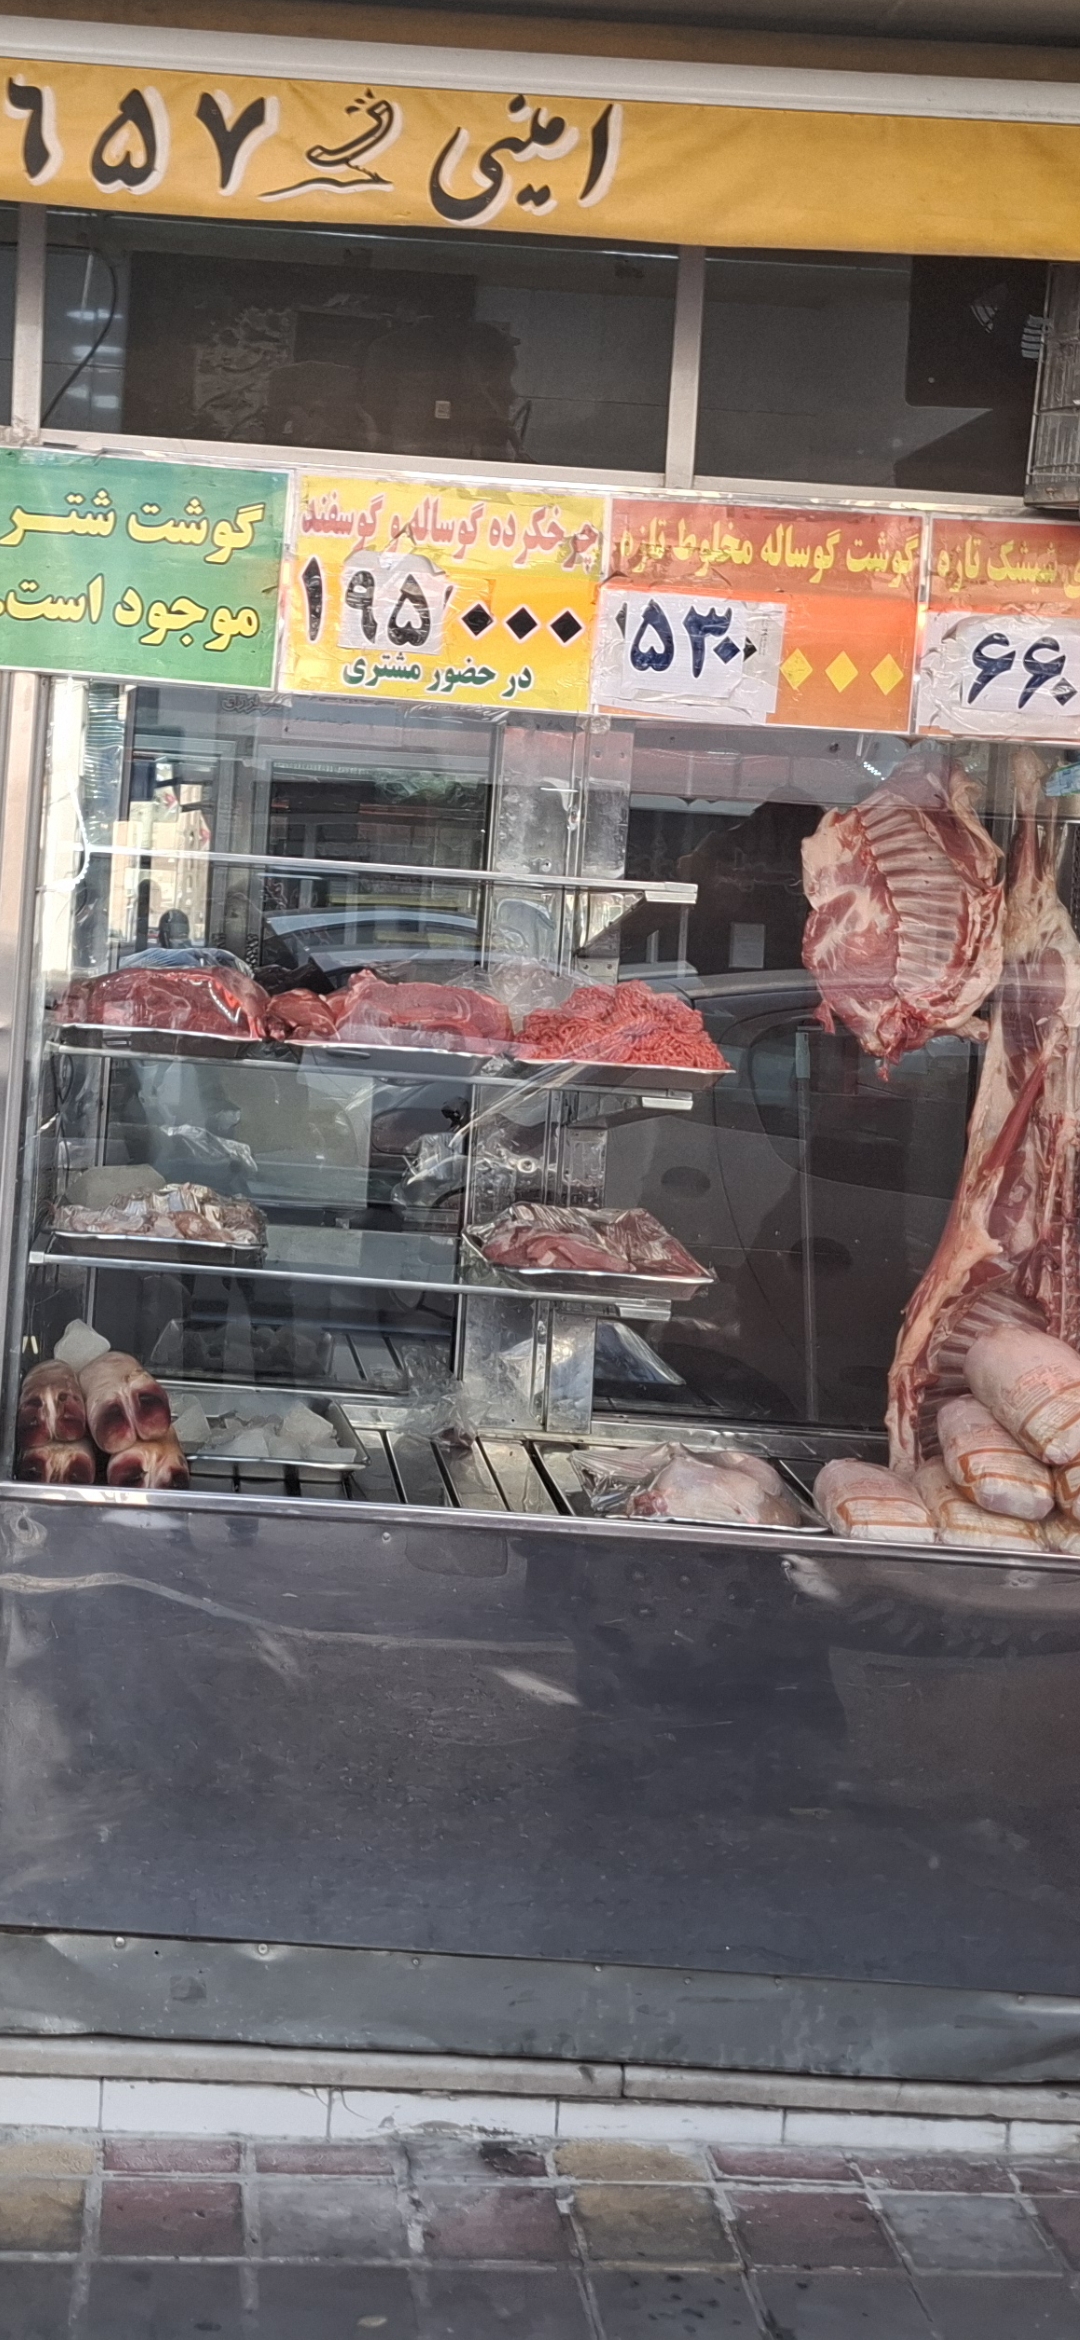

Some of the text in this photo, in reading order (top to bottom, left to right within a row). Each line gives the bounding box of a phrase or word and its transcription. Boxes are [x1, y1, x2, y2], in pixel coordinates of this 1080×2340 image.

[429, 93, 613, 222] امینی
[127, 496, 266, 564] گوشت
[301, 492, 385, 552] گوسفند
[411, 496, 485, 560] گوساله
[619, 516, 919, 588] گوشت گوساله مخلوط تازه
[936, 533, 983, 594] تازه
[114, 587, 260, 652] موجود
[343, 651, 533, 698] در حضور مشتری
